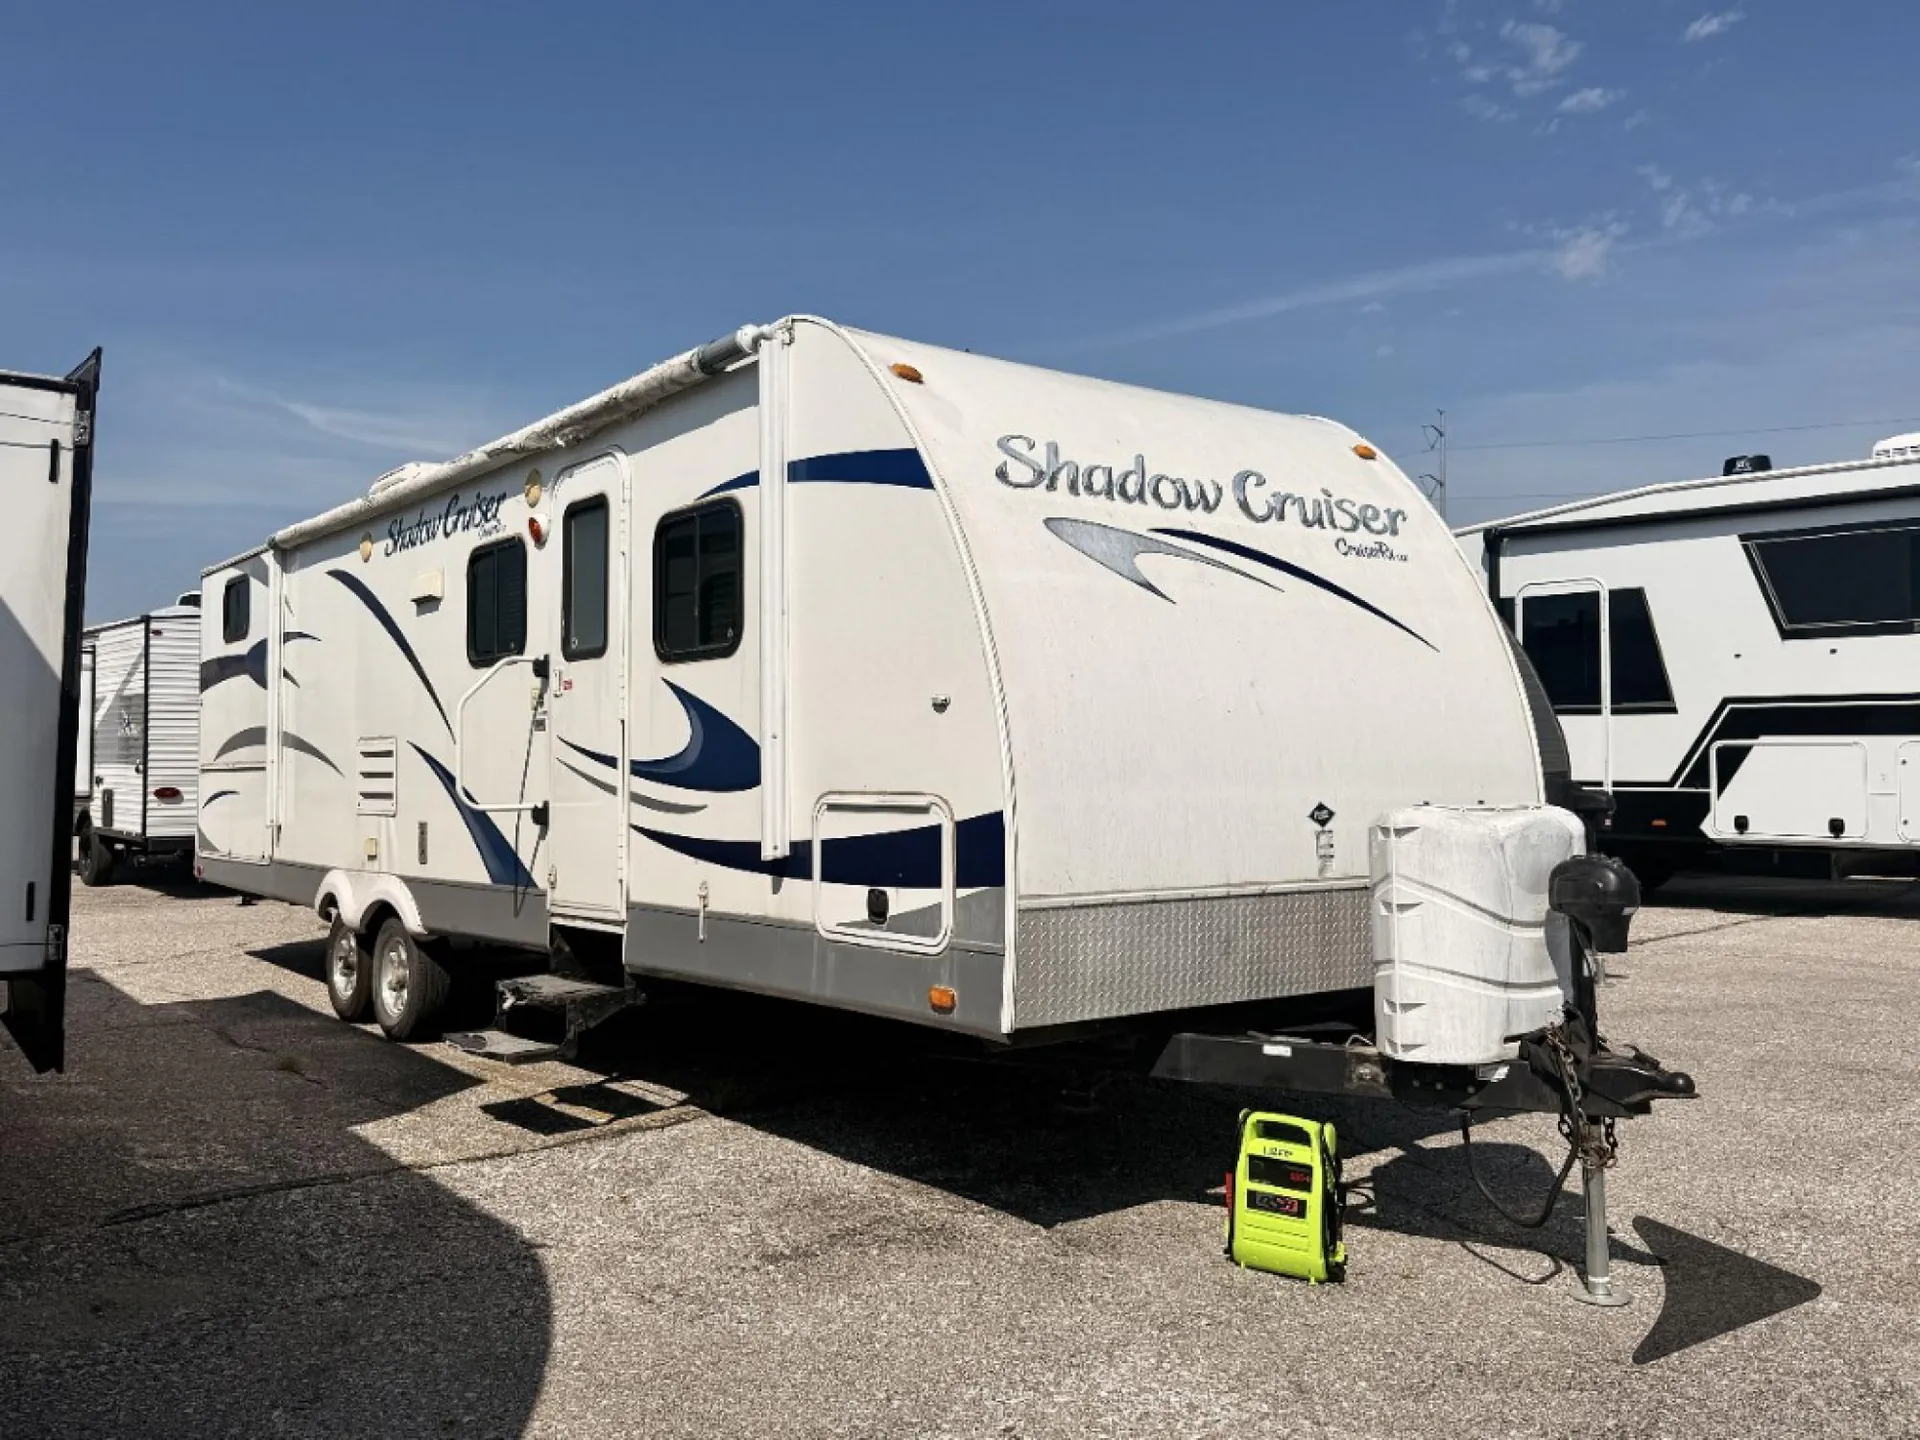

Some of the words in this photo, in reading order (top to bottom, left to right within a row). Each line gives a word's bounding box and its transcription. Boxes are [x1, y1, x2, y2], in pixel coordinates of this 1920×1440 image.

[384, 508, 442, 557] Shadow
[443, 491, 507, 538] Cruiser
[995, 434, 1223, 514] Shadow
[1231, 470, 1407, 537] Cruiser
